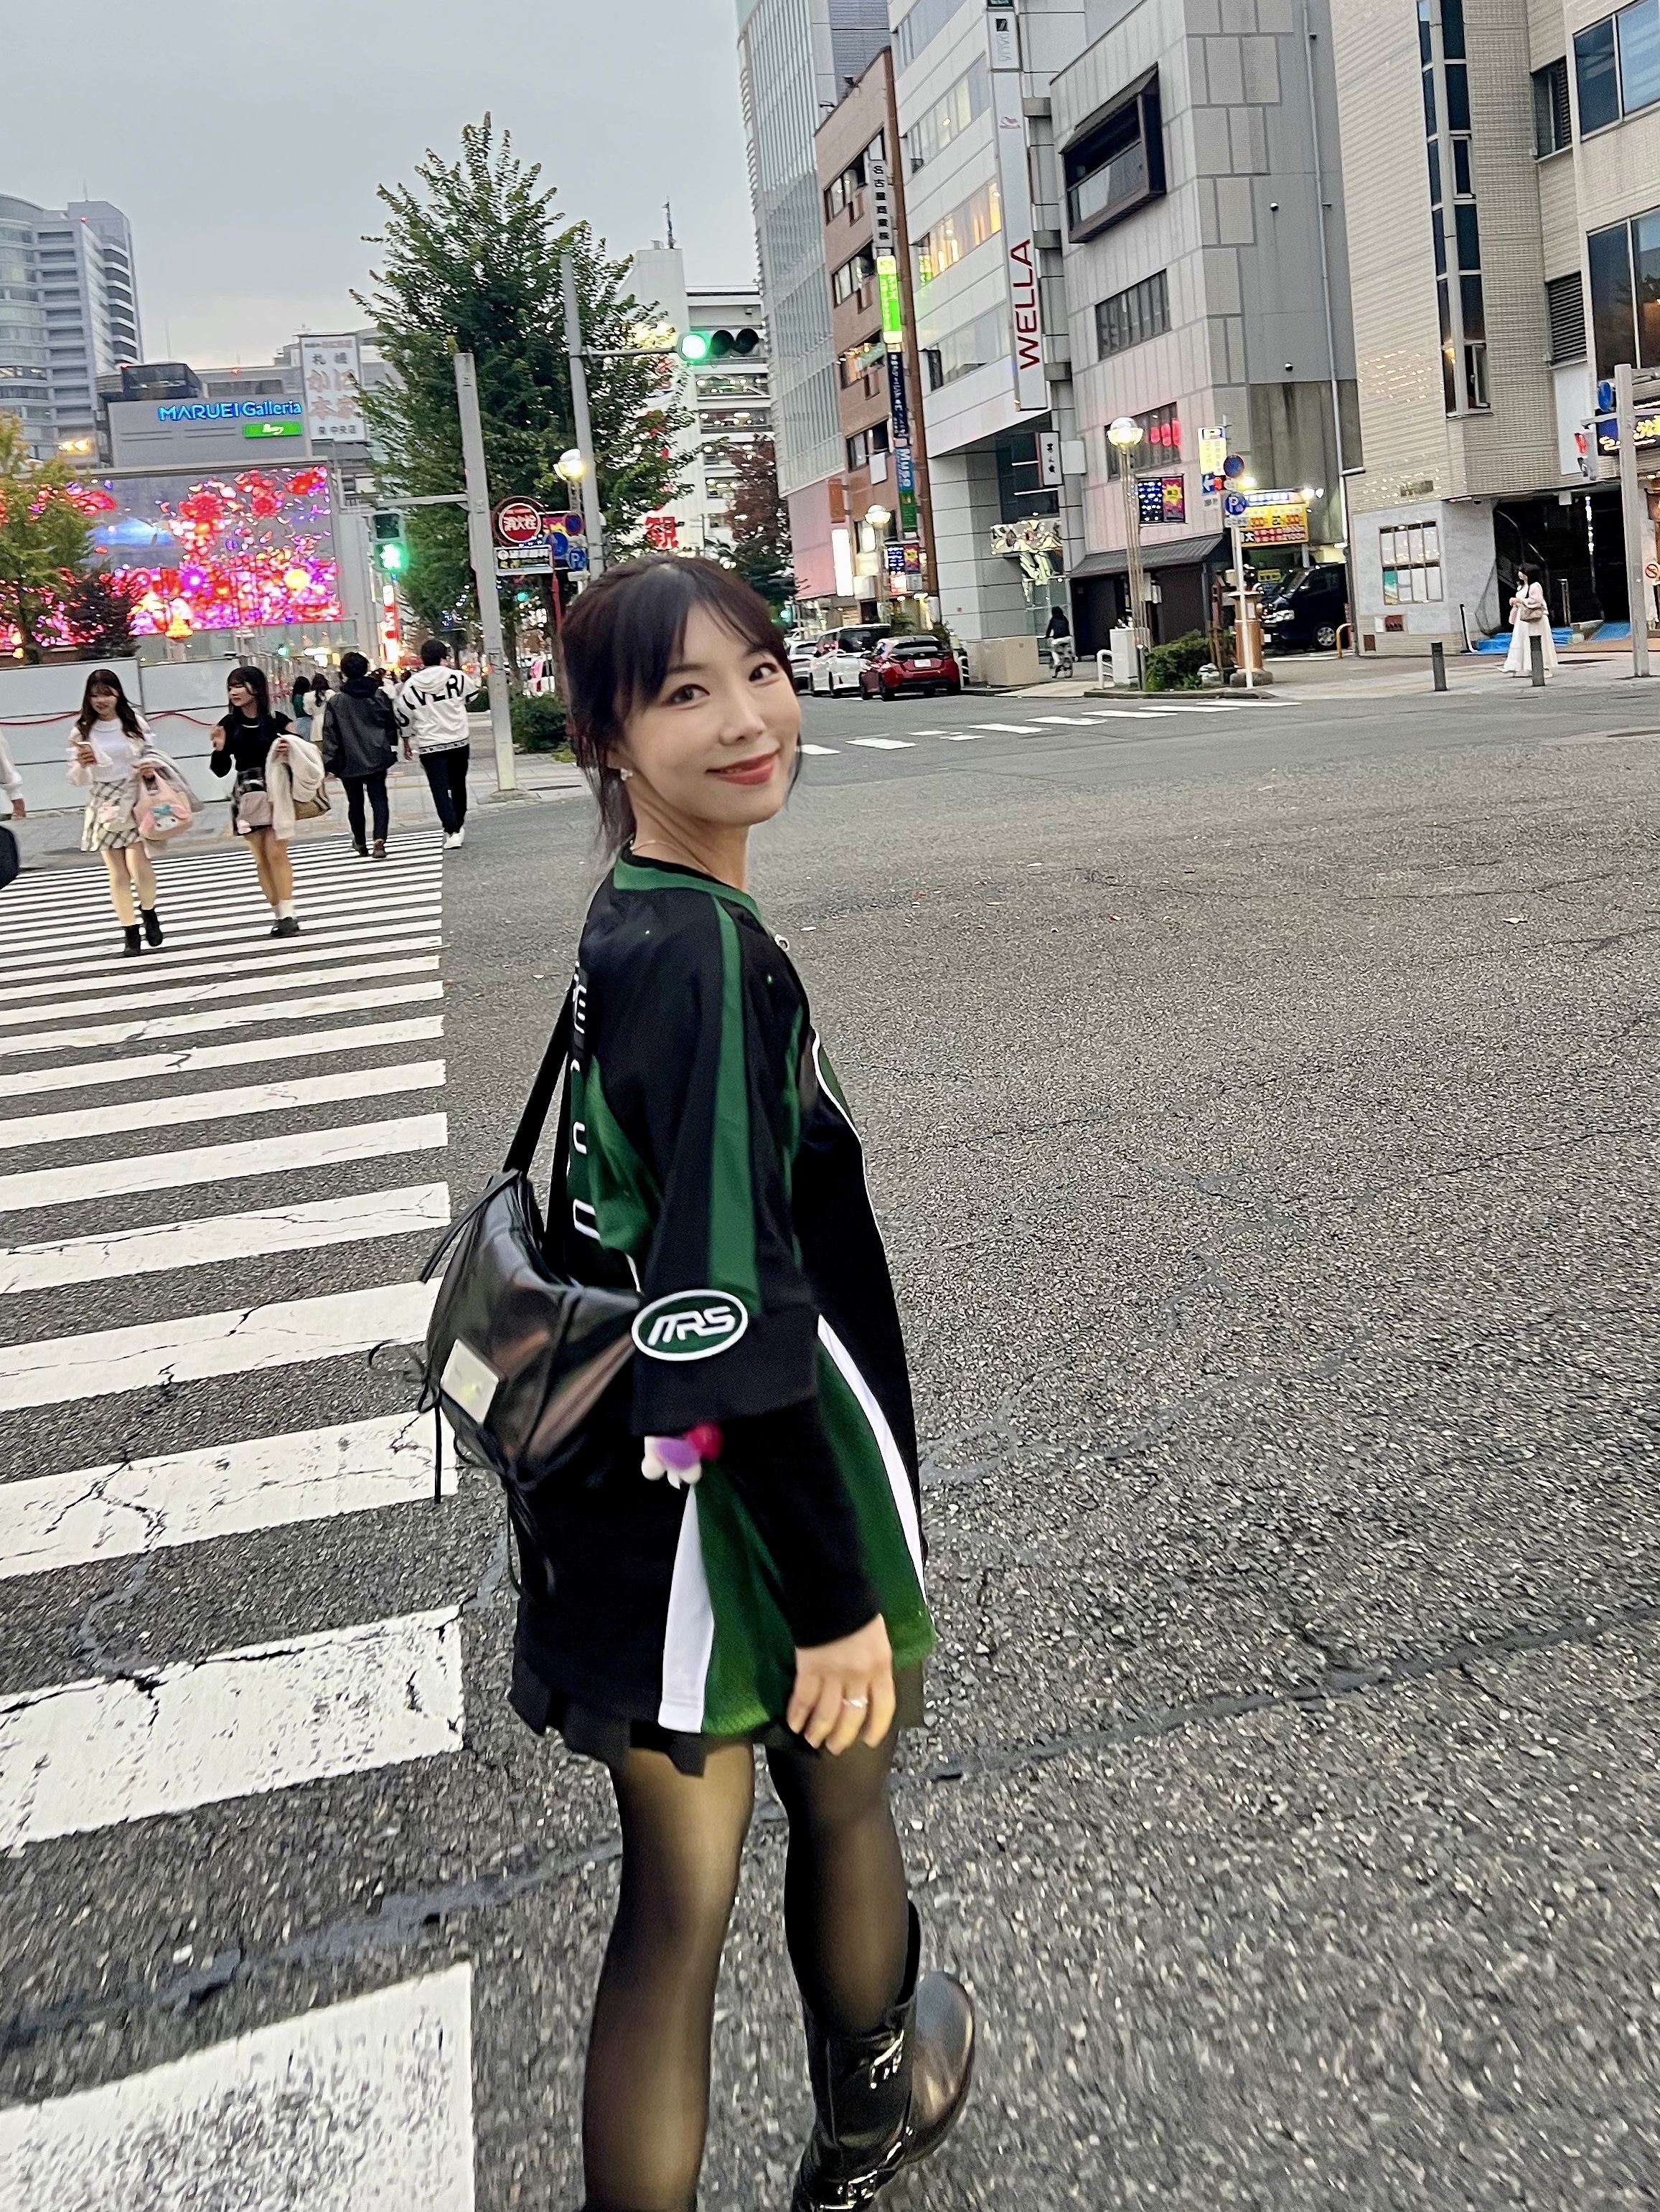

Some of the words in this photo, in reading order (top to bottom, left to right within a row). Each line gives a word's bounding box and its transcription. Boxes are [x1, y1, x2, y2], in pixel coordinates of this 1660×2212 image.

[1010, 238, 1041, 370] WELLA
[158, 403, 239, 422] MARUEI
[242, 399, 303, 417] Galleria
[503, 514, 538, 532] 消火栓
[647, 1305, 736, 1346] MRS
